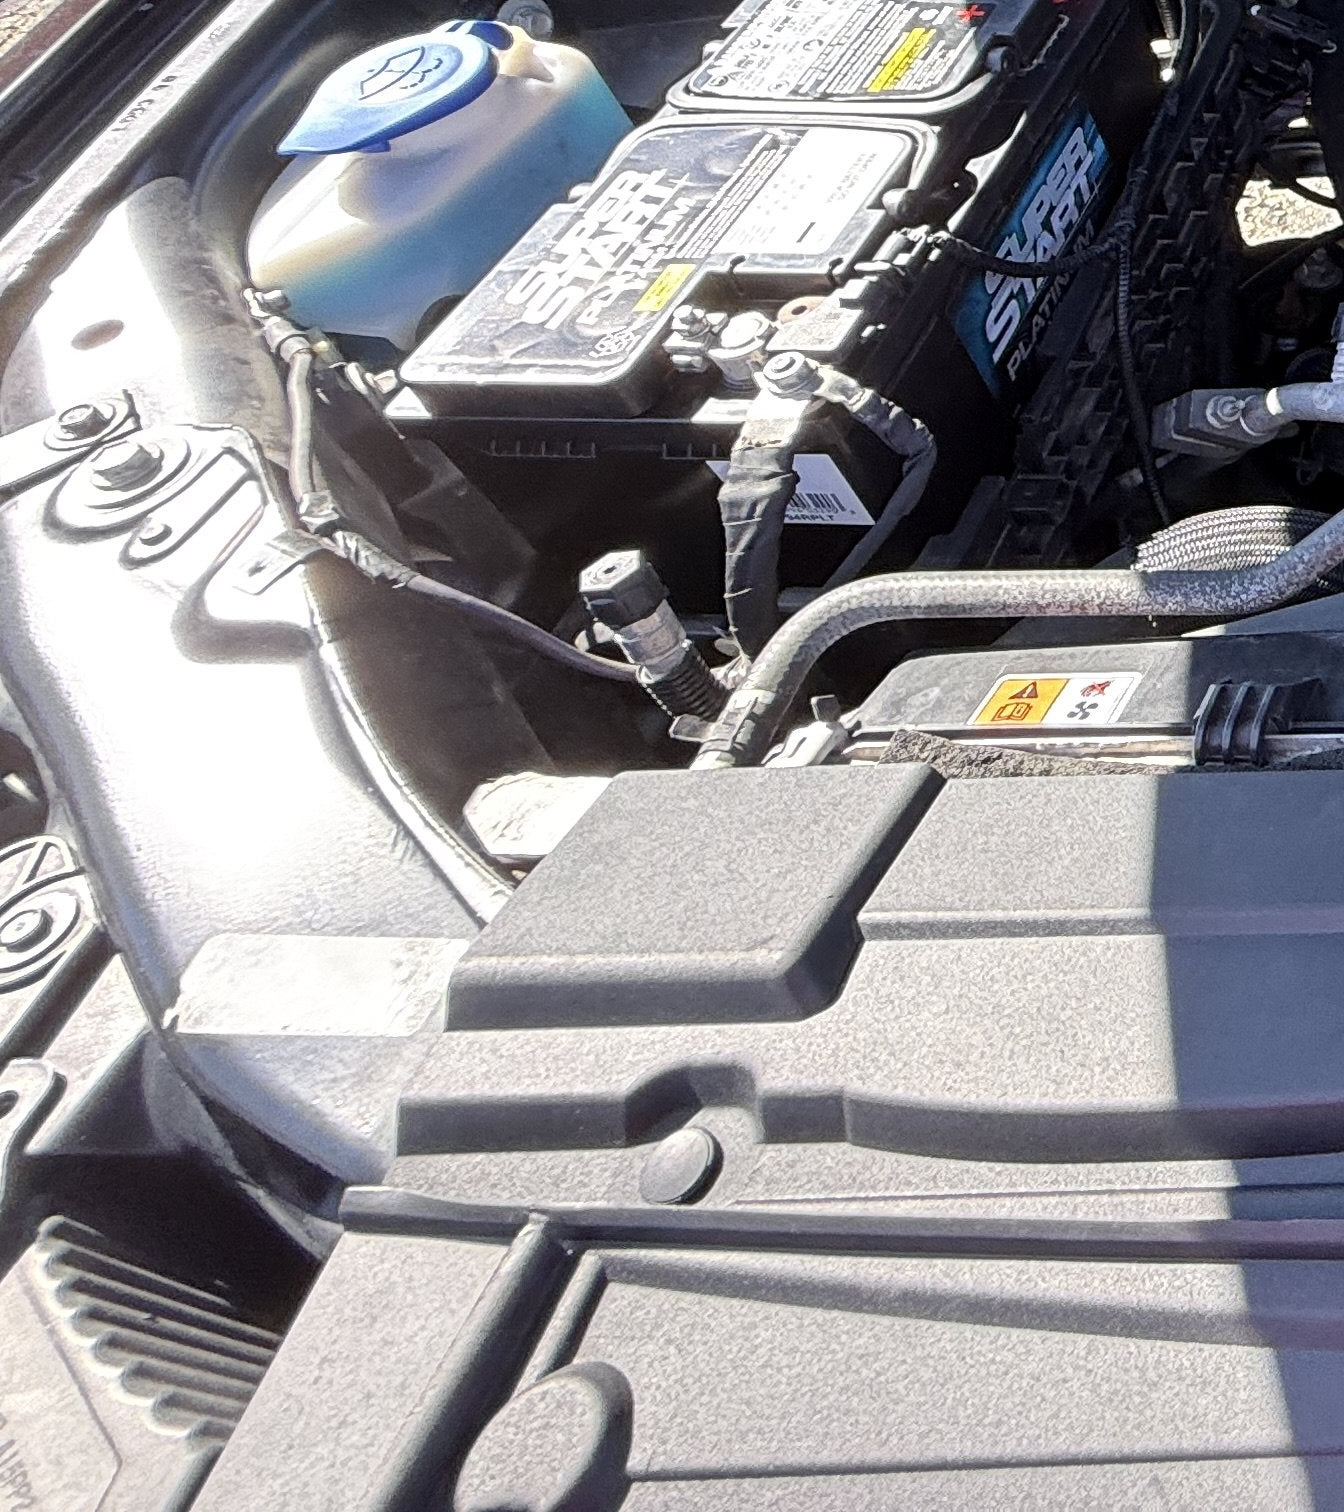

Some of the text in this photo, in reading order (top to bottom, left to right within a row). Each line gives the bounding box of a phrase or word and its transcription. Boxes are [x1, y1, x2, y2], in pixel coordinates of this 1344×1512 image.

[504, 169, 650, 304] SUPER
[522, 168, 674, 331] START
[575, 197, 696, 326] PLATINUM
[985, 149, 1094, 365] START
[1006, 219, 1095, 381] PLATINM
